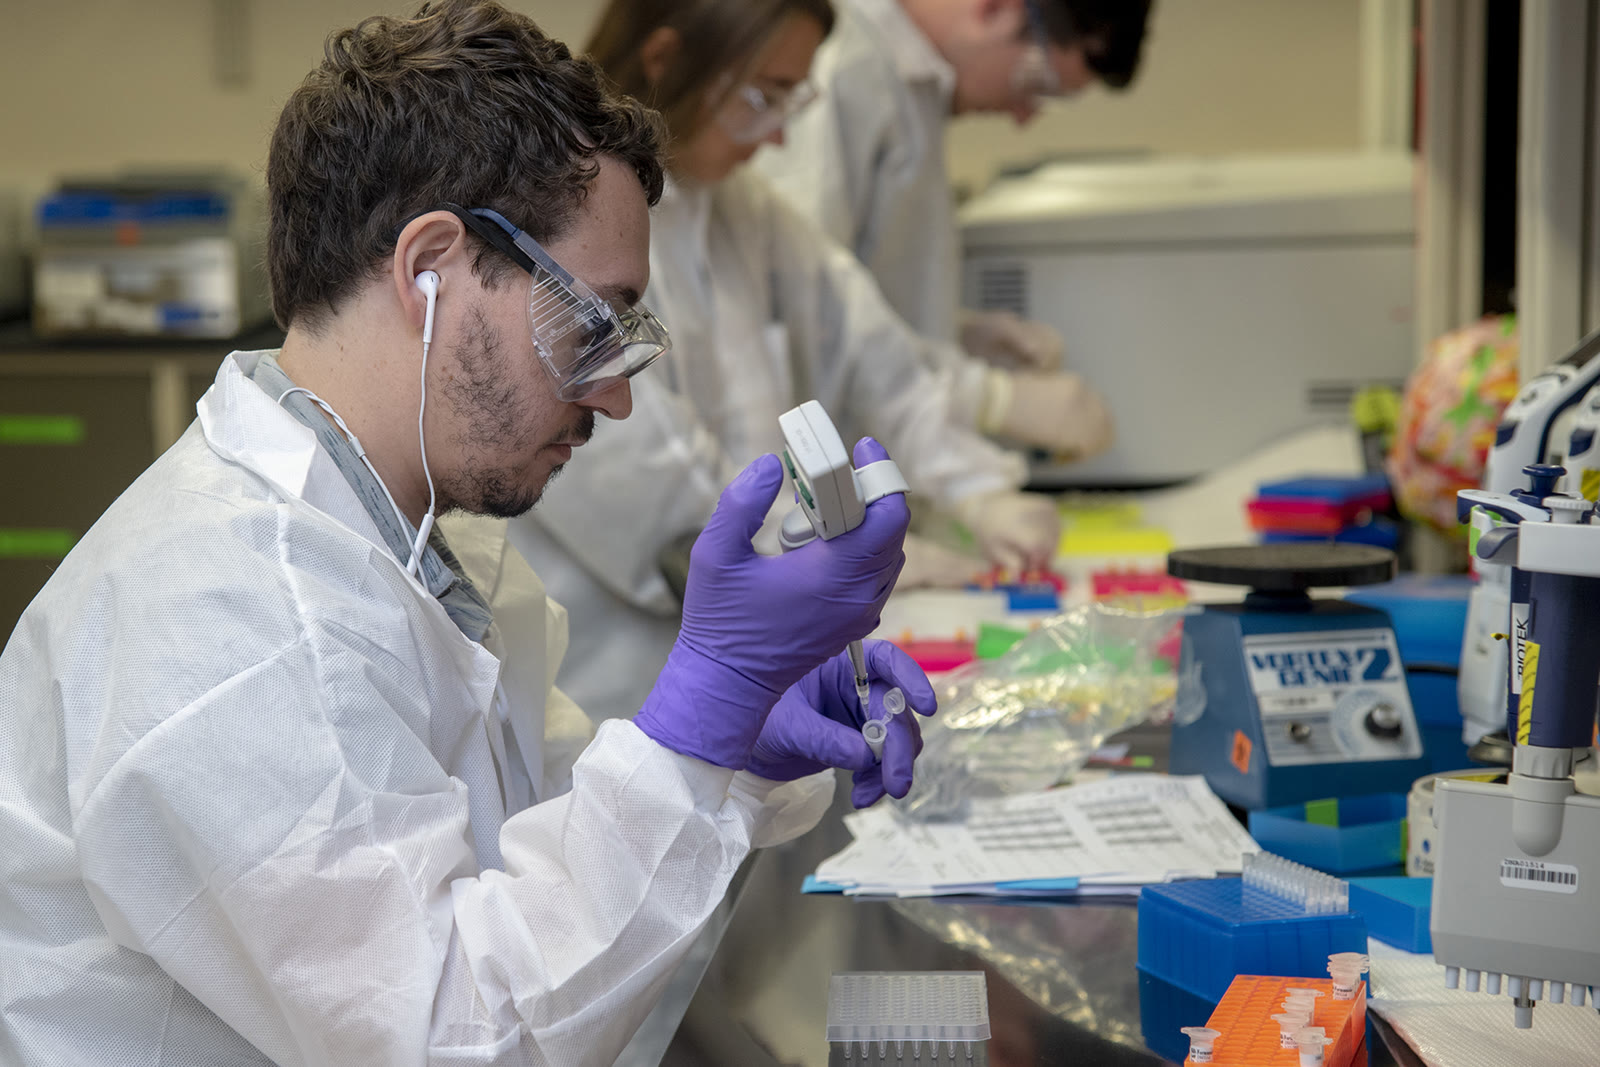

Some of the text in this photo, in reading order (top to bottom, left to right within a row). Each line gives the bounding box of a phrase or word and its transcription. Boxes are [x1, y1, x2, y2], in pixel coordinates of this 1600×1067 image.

[1251, 649, 1353, 669] VORTEX
[1356, 648, 1398, 681] 2
[1279, 669, 1352, 686] GENIE
